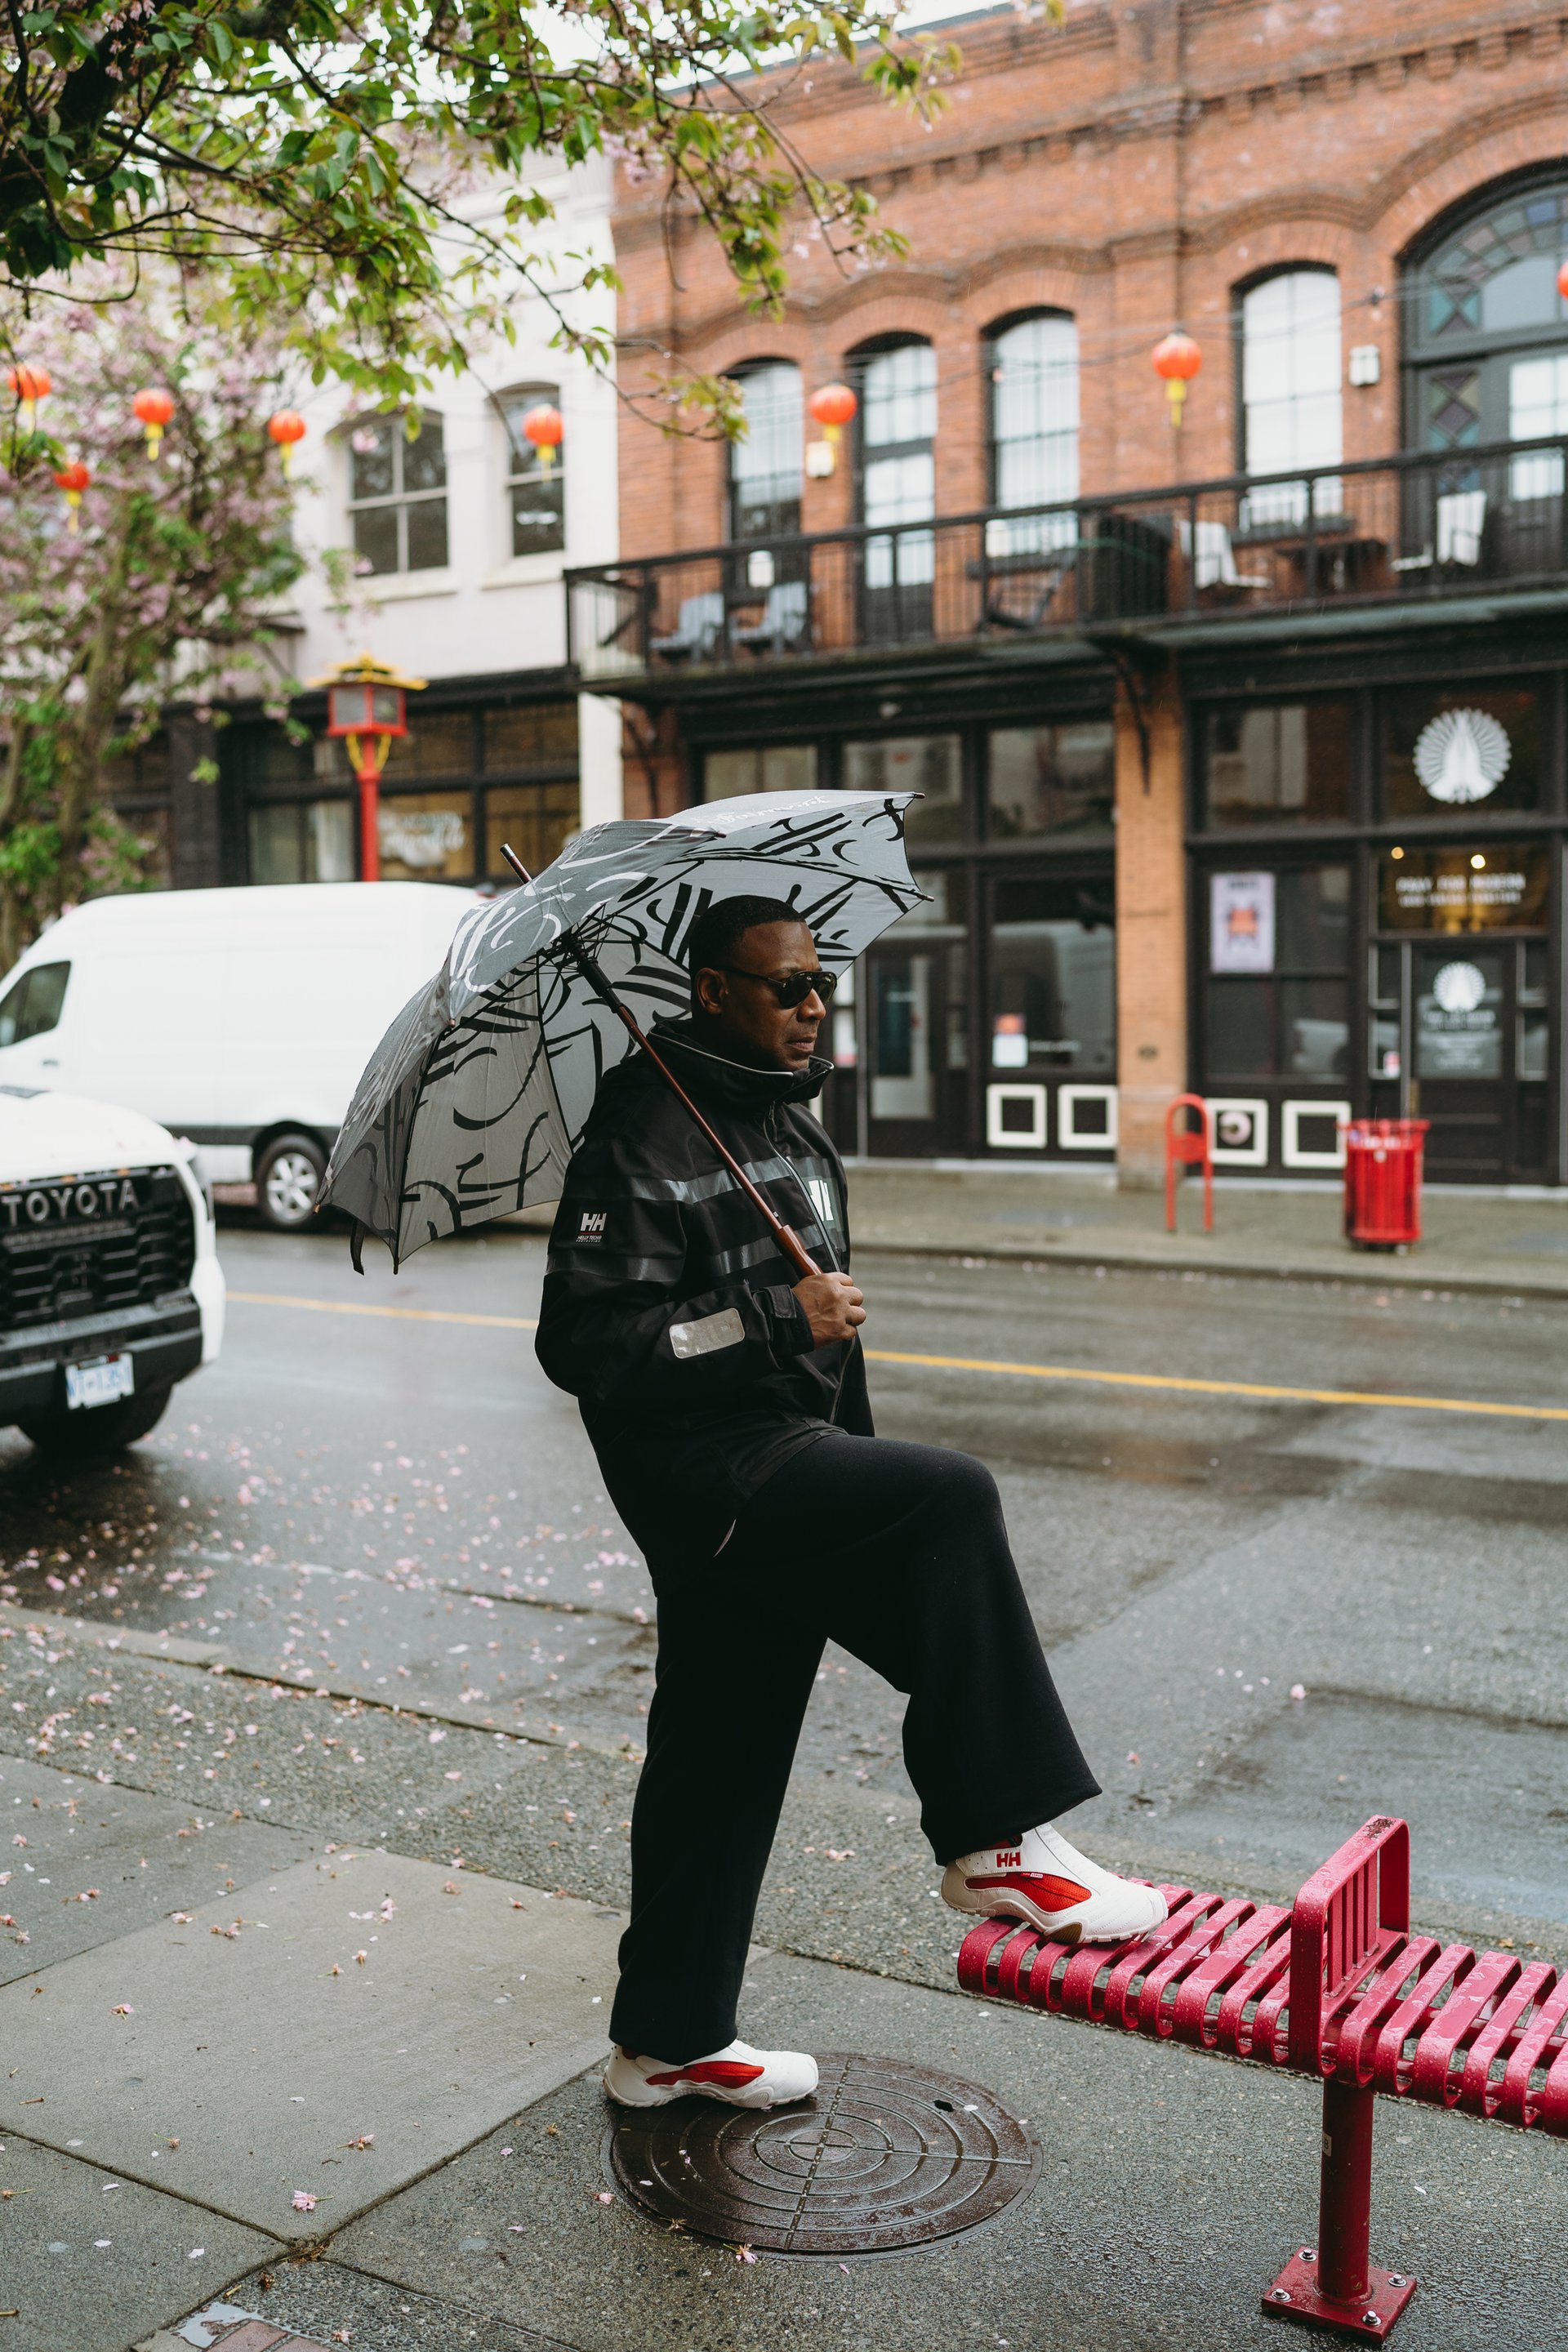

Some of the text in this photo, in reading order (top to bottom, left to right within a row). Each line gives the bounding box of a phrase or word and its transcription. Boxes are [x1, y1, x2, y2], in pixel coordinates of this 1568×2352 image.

[1, 1179, 139, 1227] TOYOTA
[580, 1213, 607, 1232] HH
[996, 1851, 1021, 1868] HH
